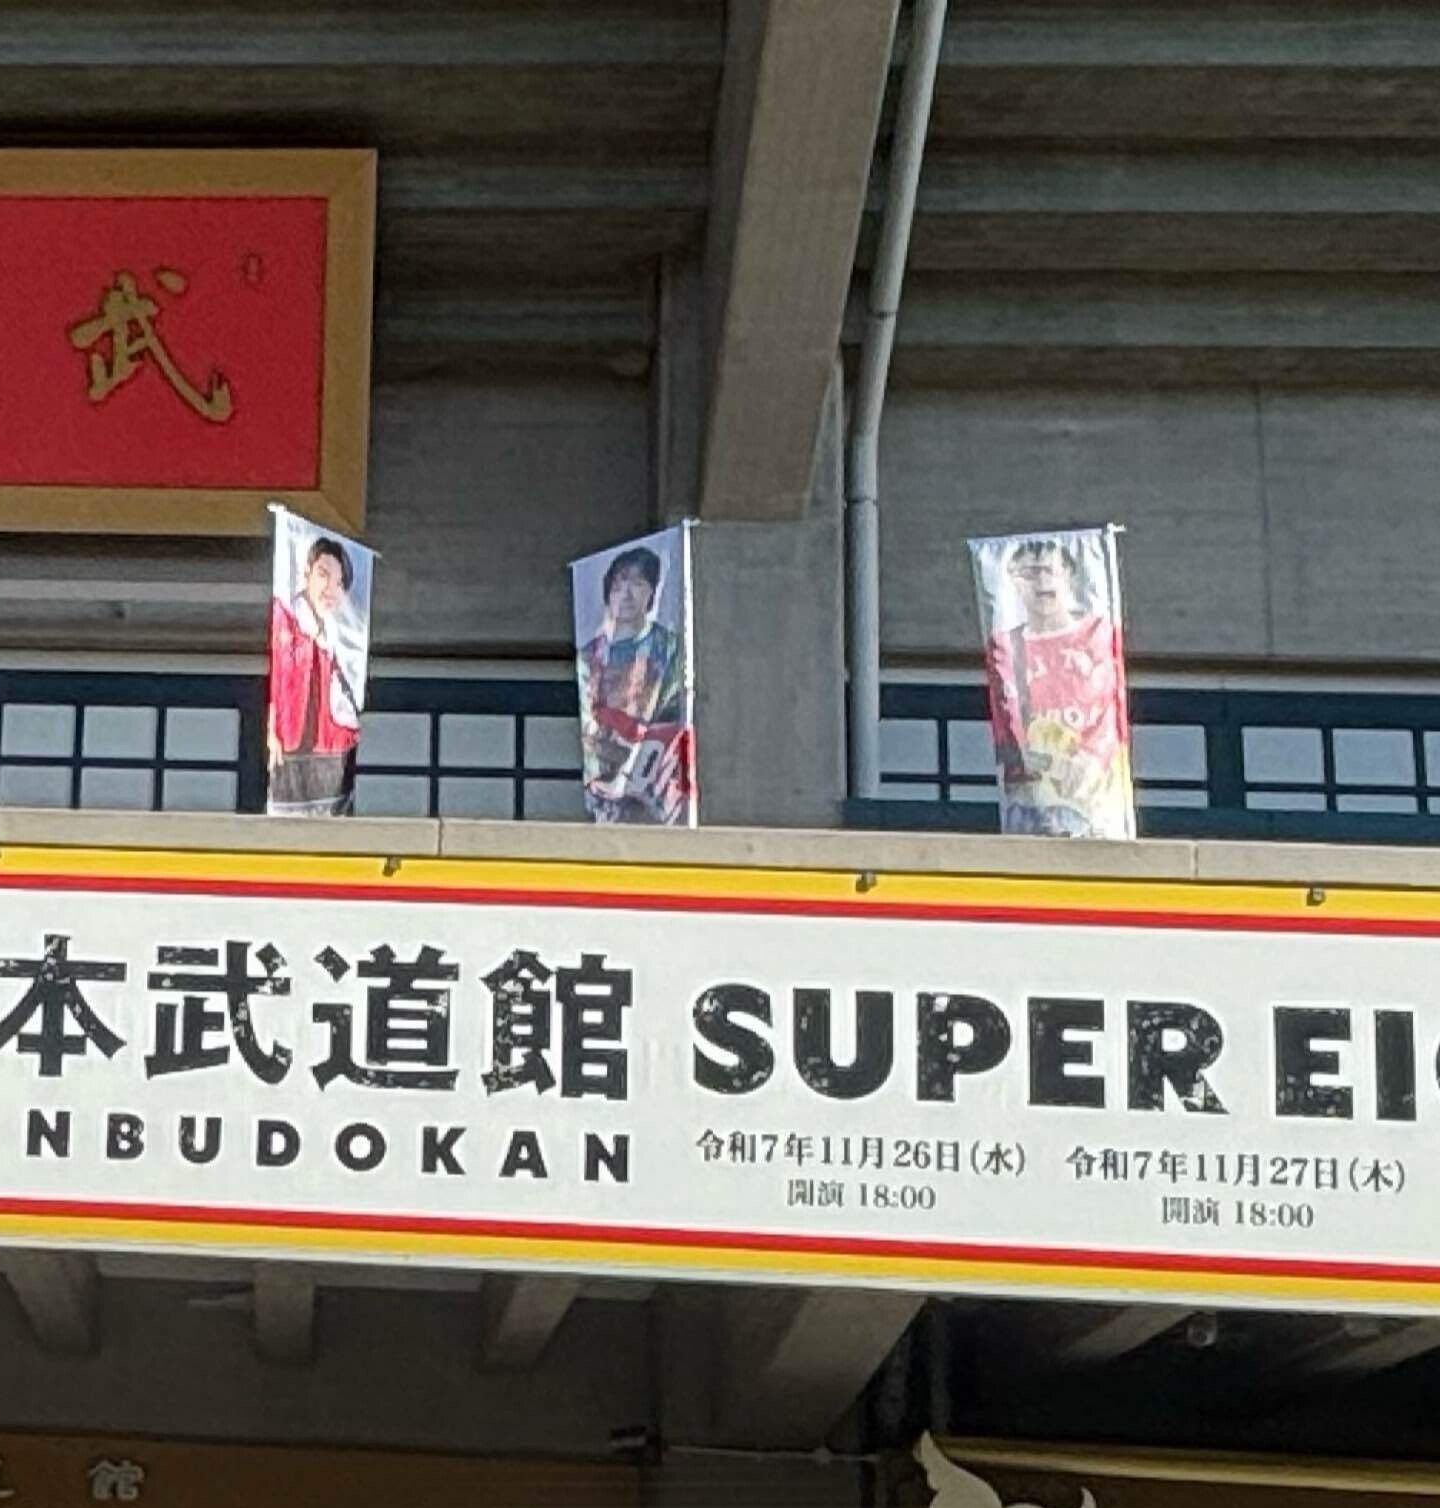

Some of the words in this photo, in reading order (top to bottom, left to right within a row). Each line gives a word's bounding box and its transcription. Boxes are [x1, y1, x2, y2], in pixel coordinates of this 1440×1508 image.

[692, 983, 1230, 1117] SUPER
[858, 1183, 937, 1210] 18:00
[1234, 1201, 1315, 1228] 18:00
